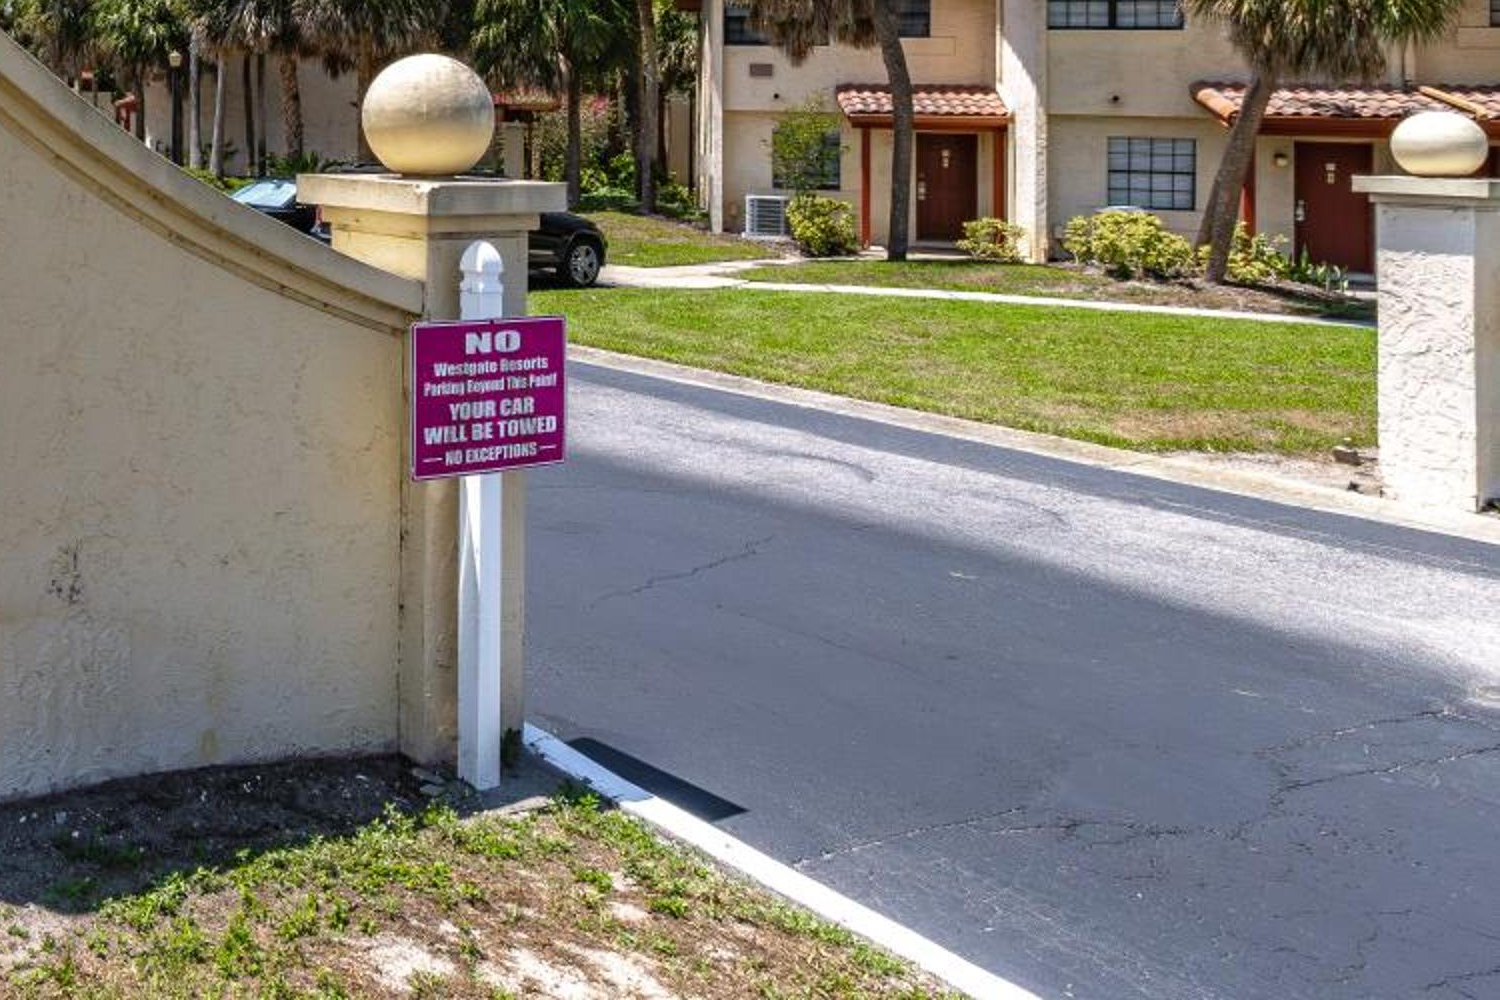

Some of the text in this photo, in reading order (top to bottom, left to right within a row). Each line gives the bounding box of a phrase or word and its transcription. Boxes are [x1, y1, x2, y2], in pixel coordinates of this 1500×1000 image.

[465, 330, 521, 355] NO
[433, 356, 548, 377] Westgate Resorts
[423, 382, 465, 397] Parking
[467, 377, 504, 393] Beyond
[506, 375, 528, 389] This
[449, 396, 535, 421] YOUR CAR
[423, 415, 557, 445] WILL BE TOWED
[445, 442, 537, 466] NO EXCEPTIONS
